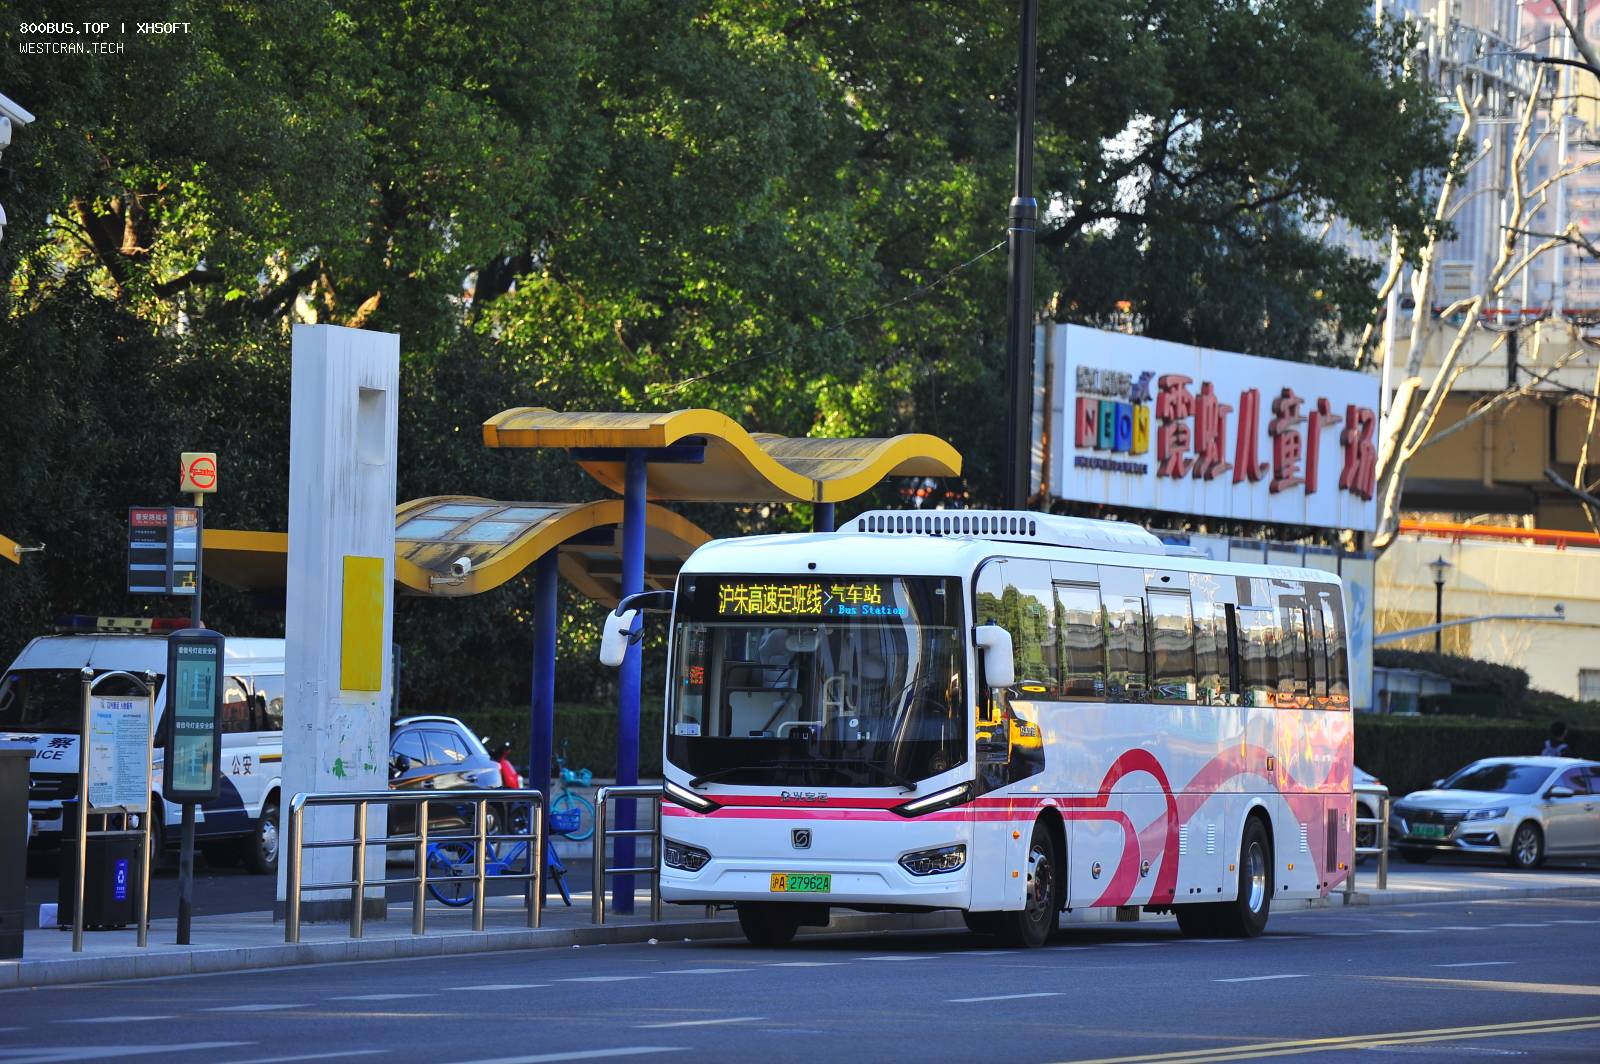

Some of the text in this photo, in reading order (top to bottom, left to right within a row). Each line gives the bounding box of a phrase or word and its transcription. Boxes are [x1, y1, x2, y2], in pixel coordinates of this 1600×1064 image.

[1085, 409, 1148, 442] NEON
[1156, 373, 1377, 501] 霓虹儿童广场
[718, 583, 882, 615] 沪朱高速定班线 汽车站
[838, 605, 905, 615] Bus Station
[231, 754, 252, 775] 公安
[790, 876, 829, 890] 27962A
